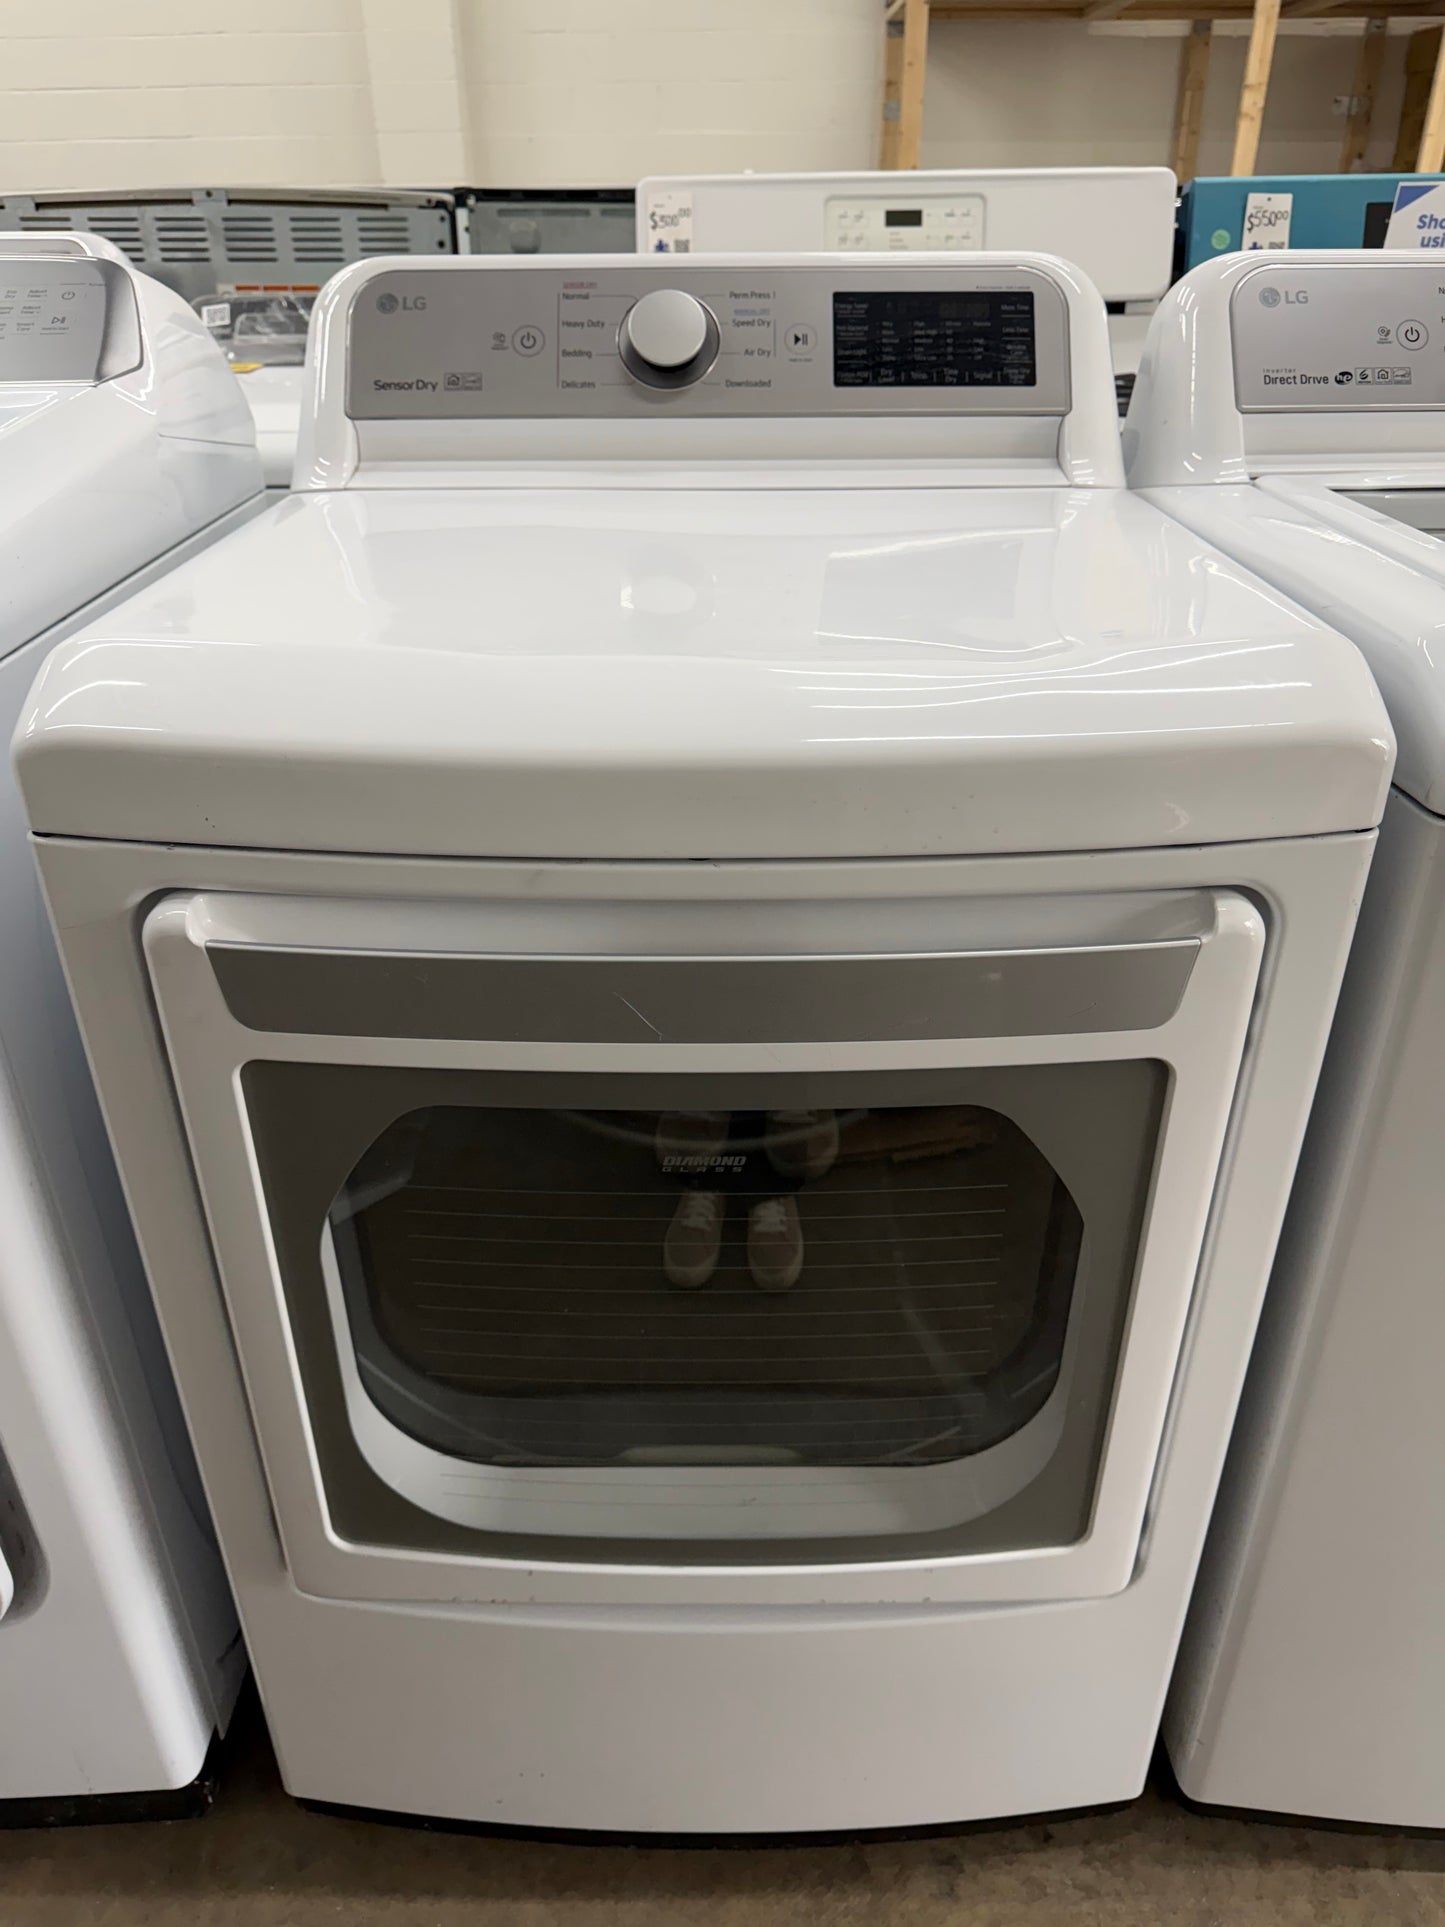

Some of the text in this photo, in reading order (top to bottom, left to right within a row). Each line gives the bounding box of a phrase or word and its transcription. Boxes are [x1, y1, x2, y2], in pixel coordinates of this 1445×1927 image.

[562, 292, 590, 300] Normal
[729, 291, 771, 299] Perm Press
[1285, 290, 1310, 304] LG
[402, 296, 428, 311] LG
[561, 319, 605, 330] Heavy Duty
[731, 319, 771, 328] Speed Dry
[561, 349, 593, 359] Bedding
[743, 348, 771, 358] Air Dry
[561, 380, 596, 389] Delicates
[725, 379, 772, 388] Downloaded
[1263, 374, 1298, 385] Direct
[1300, 374, 1329, 385] Drive
[662, 1156, 747, 1166] DIAMOND
